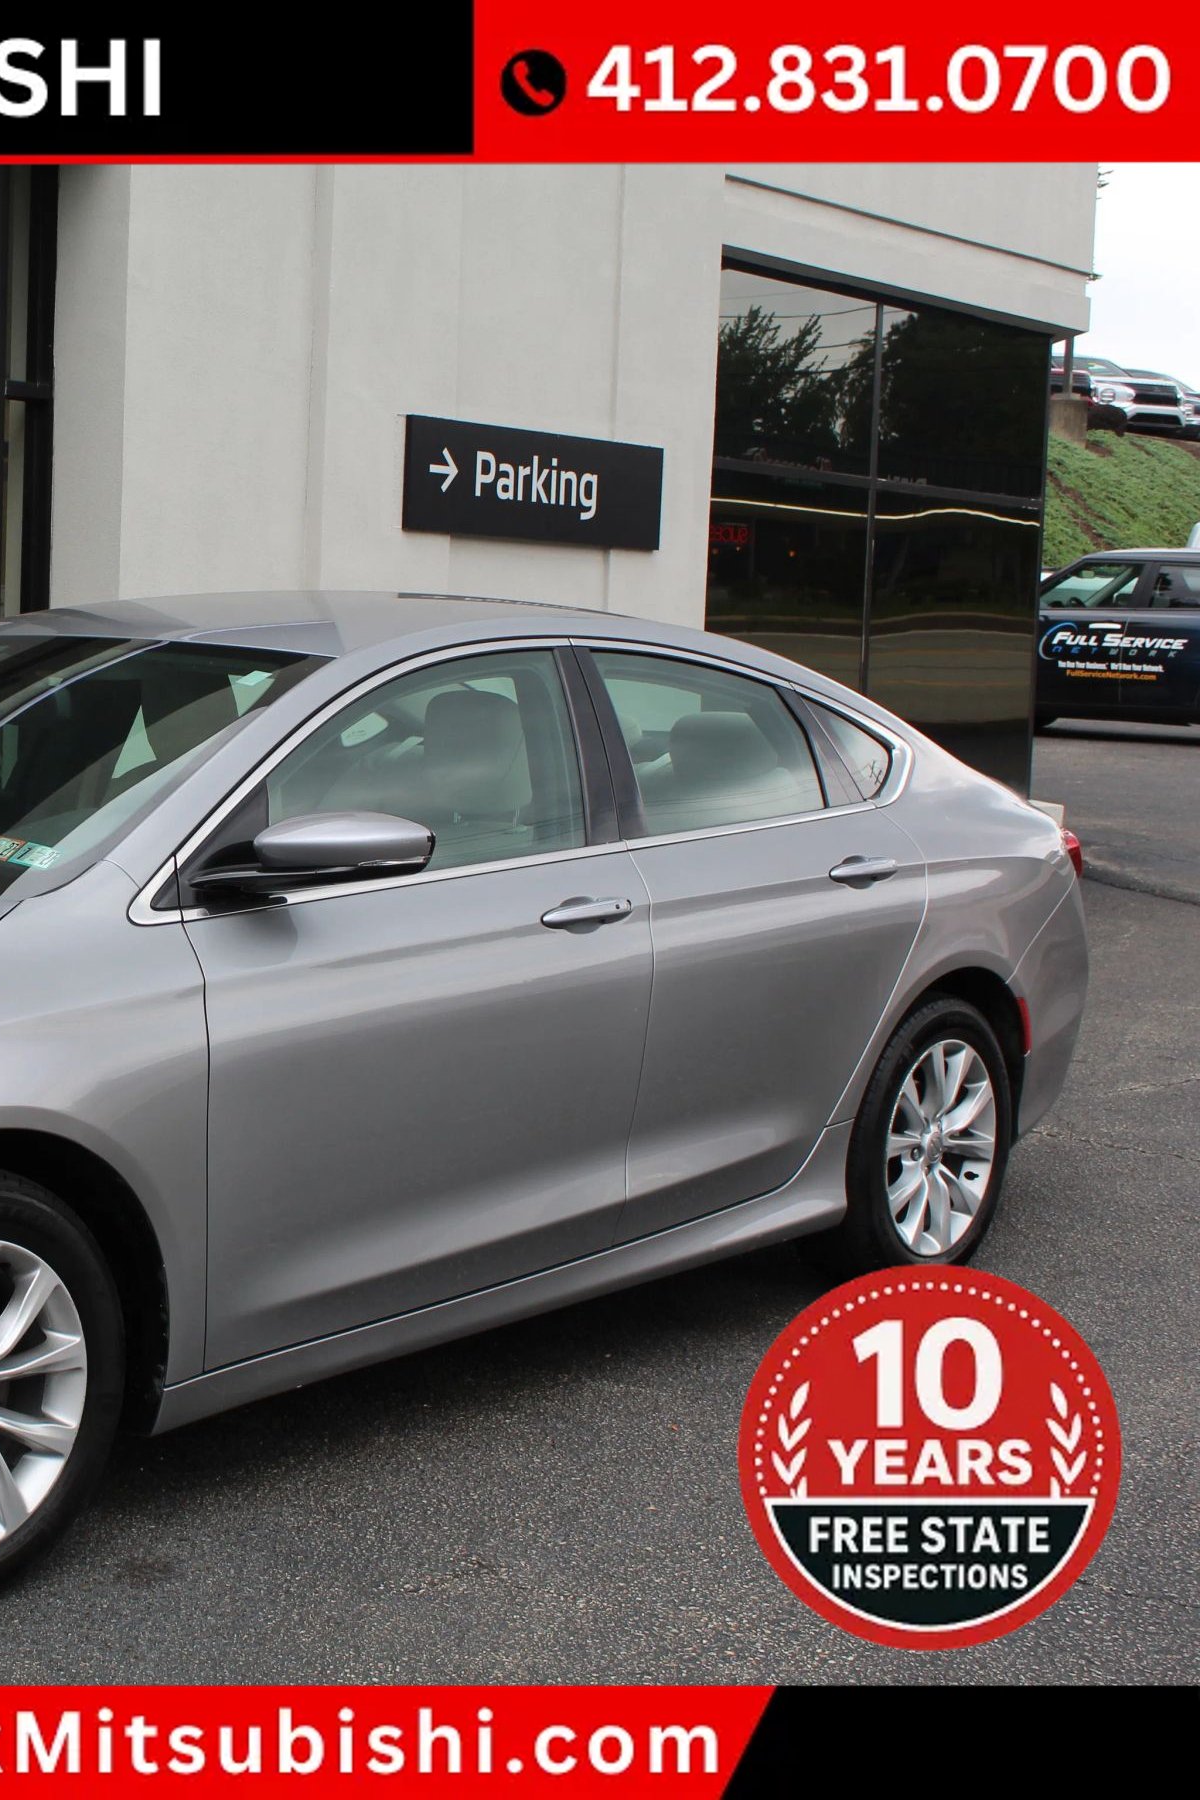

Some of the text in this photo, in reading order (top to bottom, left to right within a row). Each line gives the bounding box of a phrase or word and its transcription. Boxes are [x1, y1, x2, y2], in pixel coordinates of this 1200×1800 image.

[475, 450, 598, 520] Parking
[1052, 631, 1189, 650] FULL SERVICE
